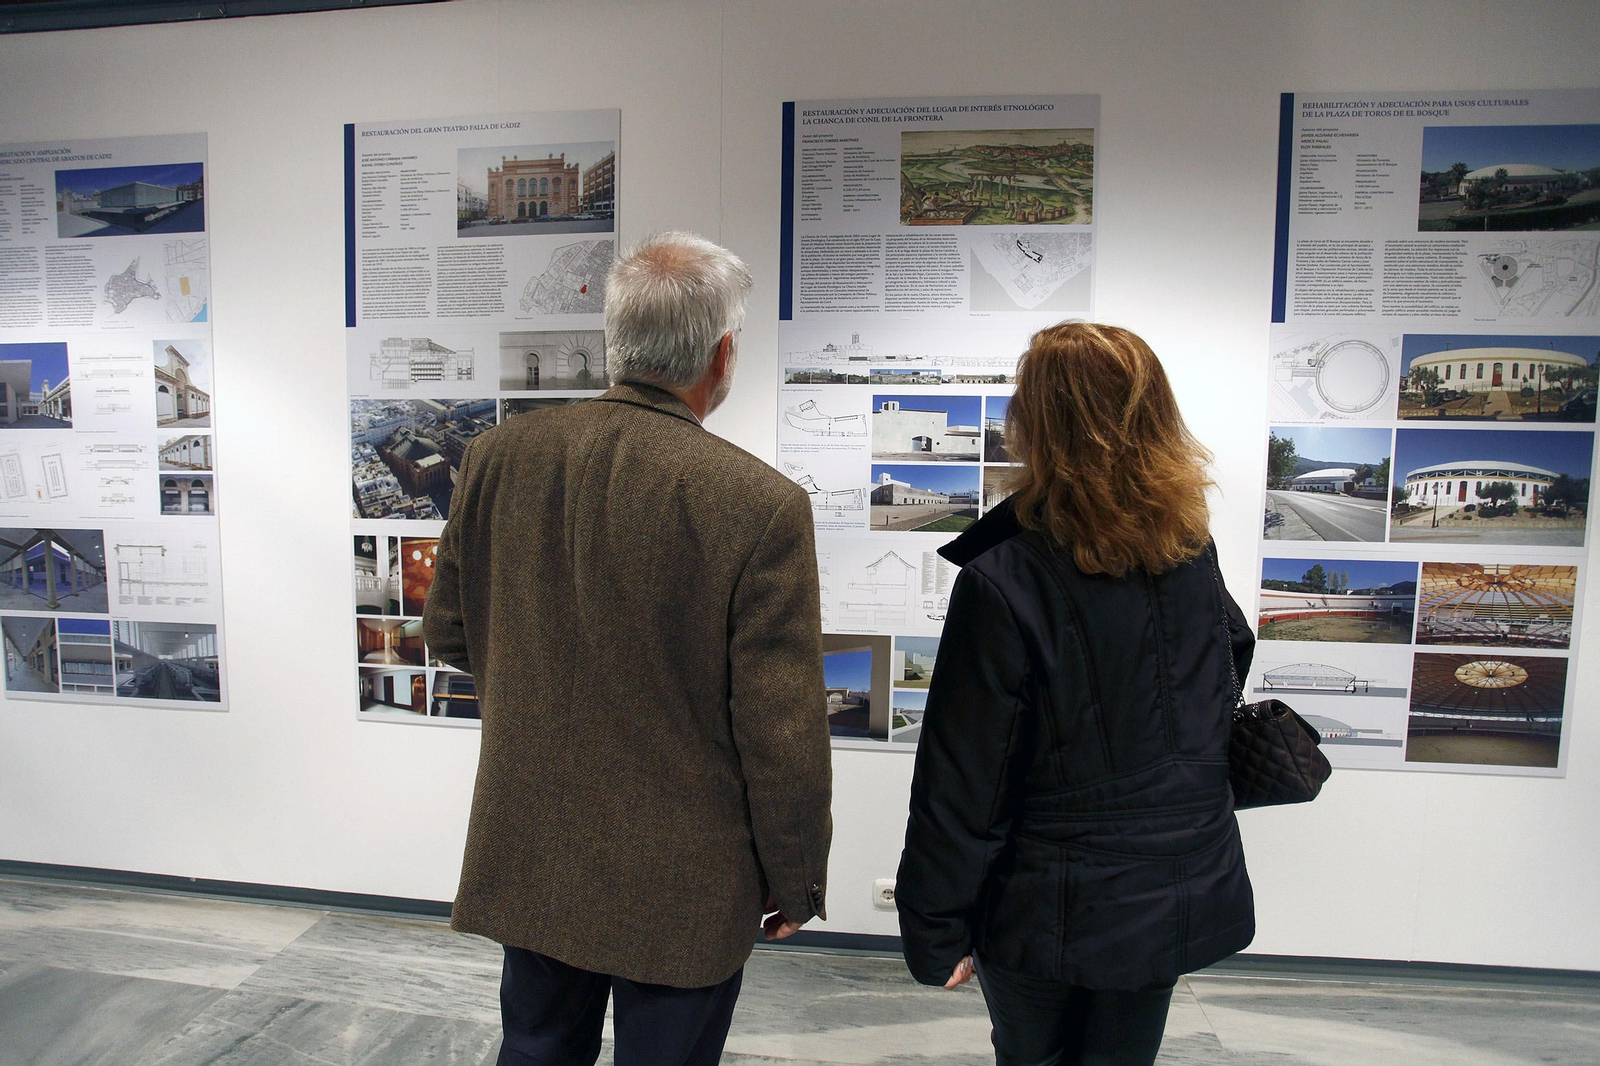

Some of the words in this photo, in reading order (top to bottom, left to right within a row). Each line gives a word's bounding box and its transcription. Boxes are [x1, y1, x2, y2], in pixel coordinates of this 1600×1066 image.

[1302, 100, 1369, 109] REHABILITACIÓN
[802, 108, 860, 116] RESTAURACIÓN
[361, 129, 409, 137] RESTAURACIÓN
